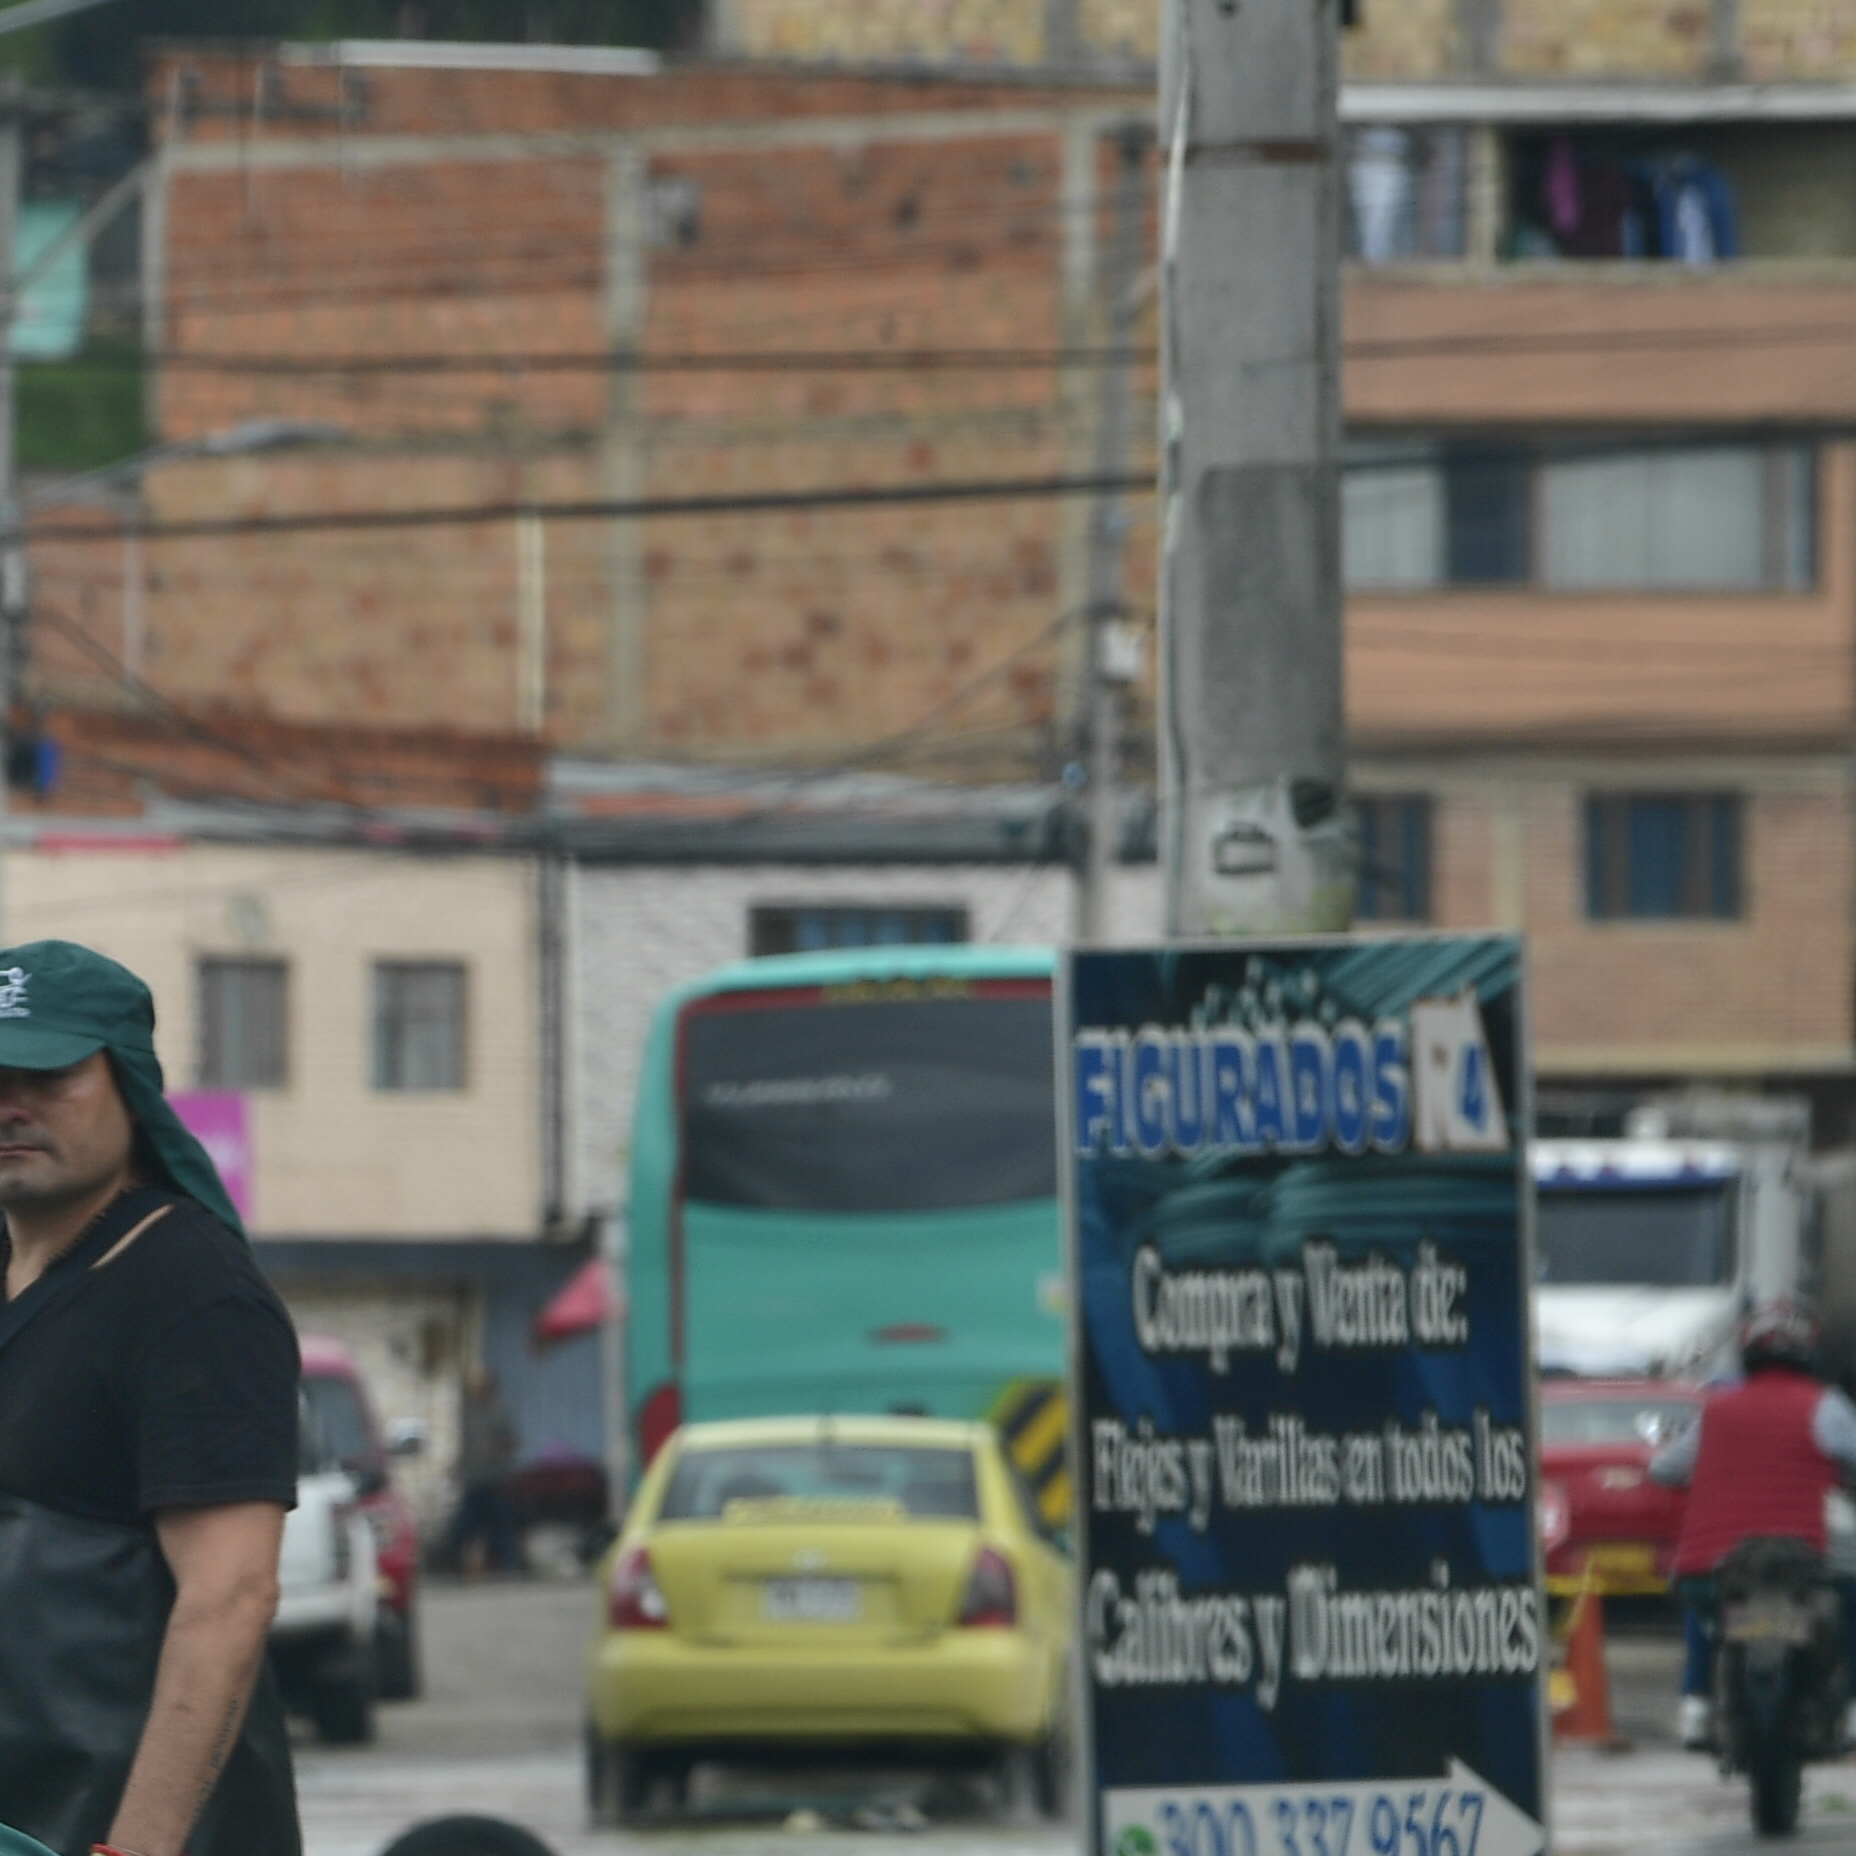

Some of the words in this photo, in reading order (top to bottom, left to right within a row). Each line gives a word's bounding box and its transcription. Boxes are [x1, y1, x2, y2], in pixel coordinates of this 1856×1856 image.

[1074, 1019, 1409, 1155] FIGURADOS
[1132, 1243, 1275, 1374] Compra
[1275, 1267, 1303, 1374] y
[1303, 1239, 1408, 1346] Venta
[1411, 1239, 1469, 1342] de:
[1188, 1439, 1213, 1534] y
[1213, 1412, 1340, 1507] Varillas
[1341, 1433, 1384, 1501] en
[1385, 1409, 1474, 1501] todos
[1474, 1408, 1526, 1499] los
[1089, 1567, 1253, 1686] Calibres
[1254, 1595, 1286, 1711] y
[1287, 1559, 1538, 1680] Dimensiones
